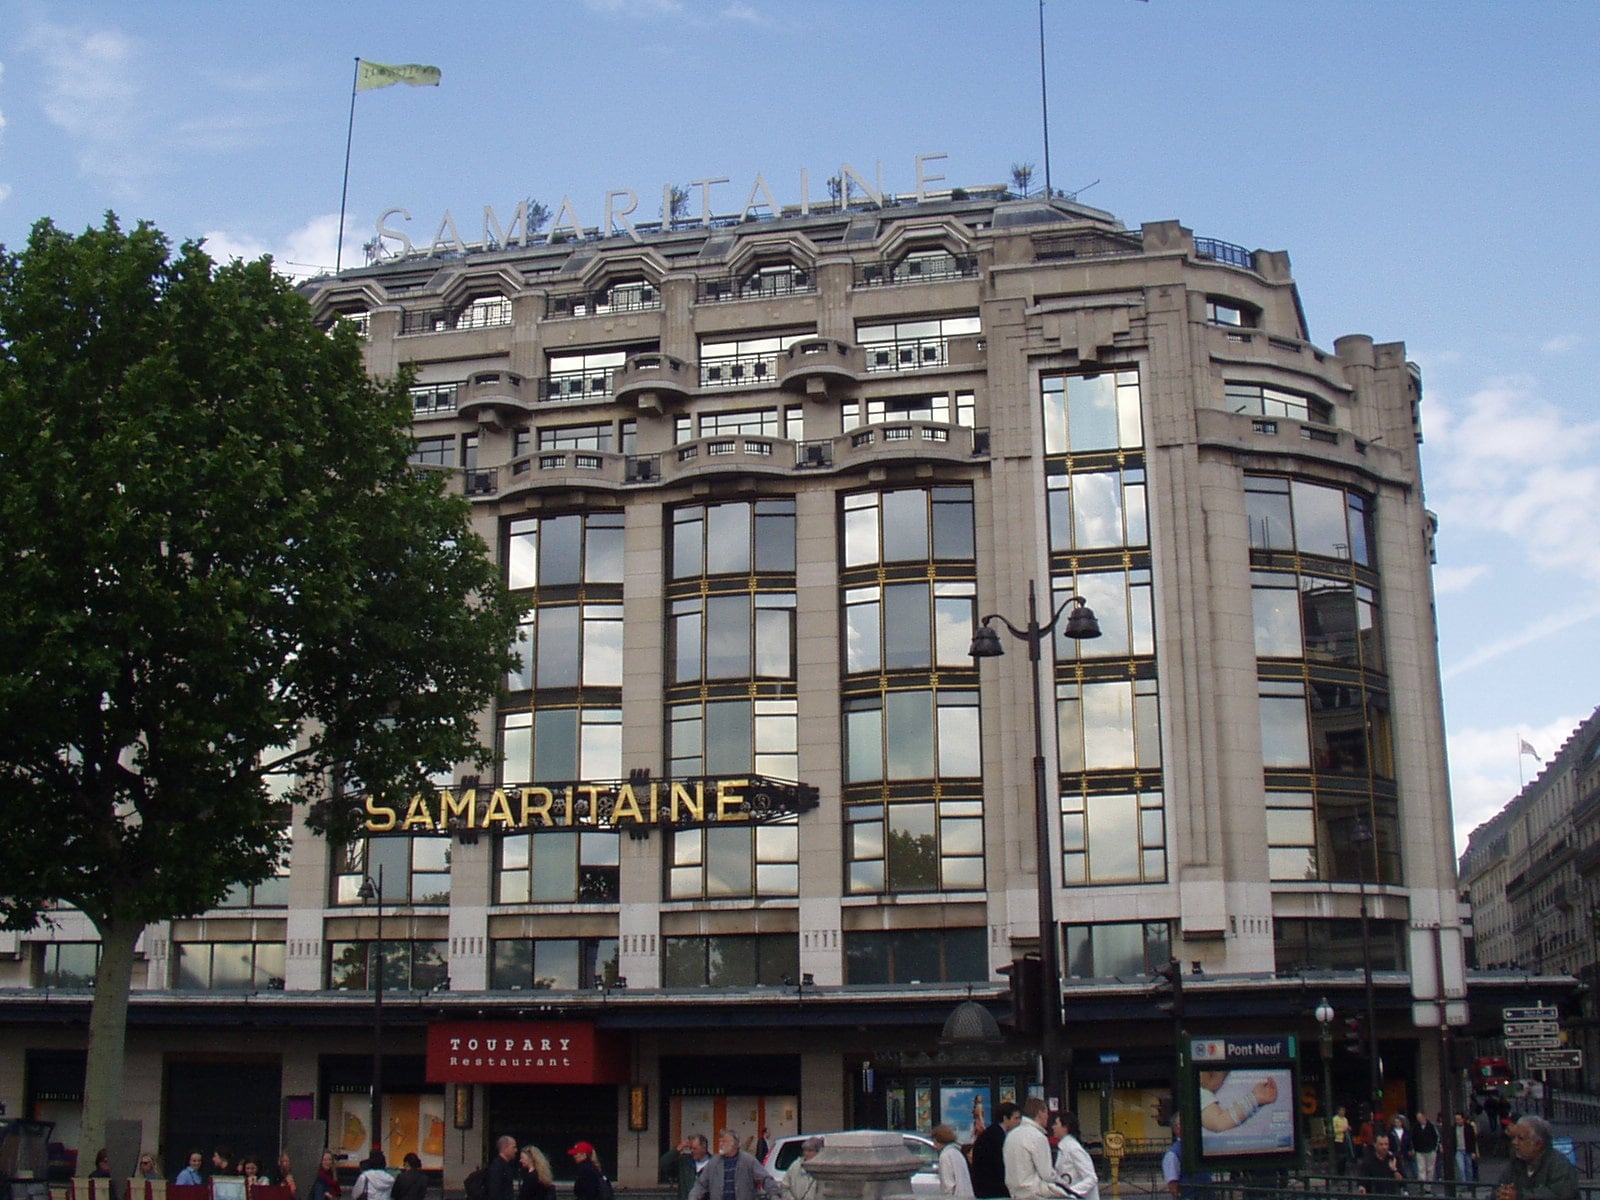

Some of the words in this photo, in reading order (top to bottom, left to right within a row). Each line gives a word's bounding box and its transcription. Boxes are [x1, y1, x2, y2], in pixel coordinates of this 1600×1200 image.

[375, 151, 949, 260] SAMARITAINE
[364, 779, 751, 832] SAMARITAINE
[450, 1038, 571, 1051] TOUPARY
[1227, 1043, 1253, 1056] Pont
[1255, 1042, 1280, 1055] Neuf
[450, 1056, 571, 1067] Restaurant
